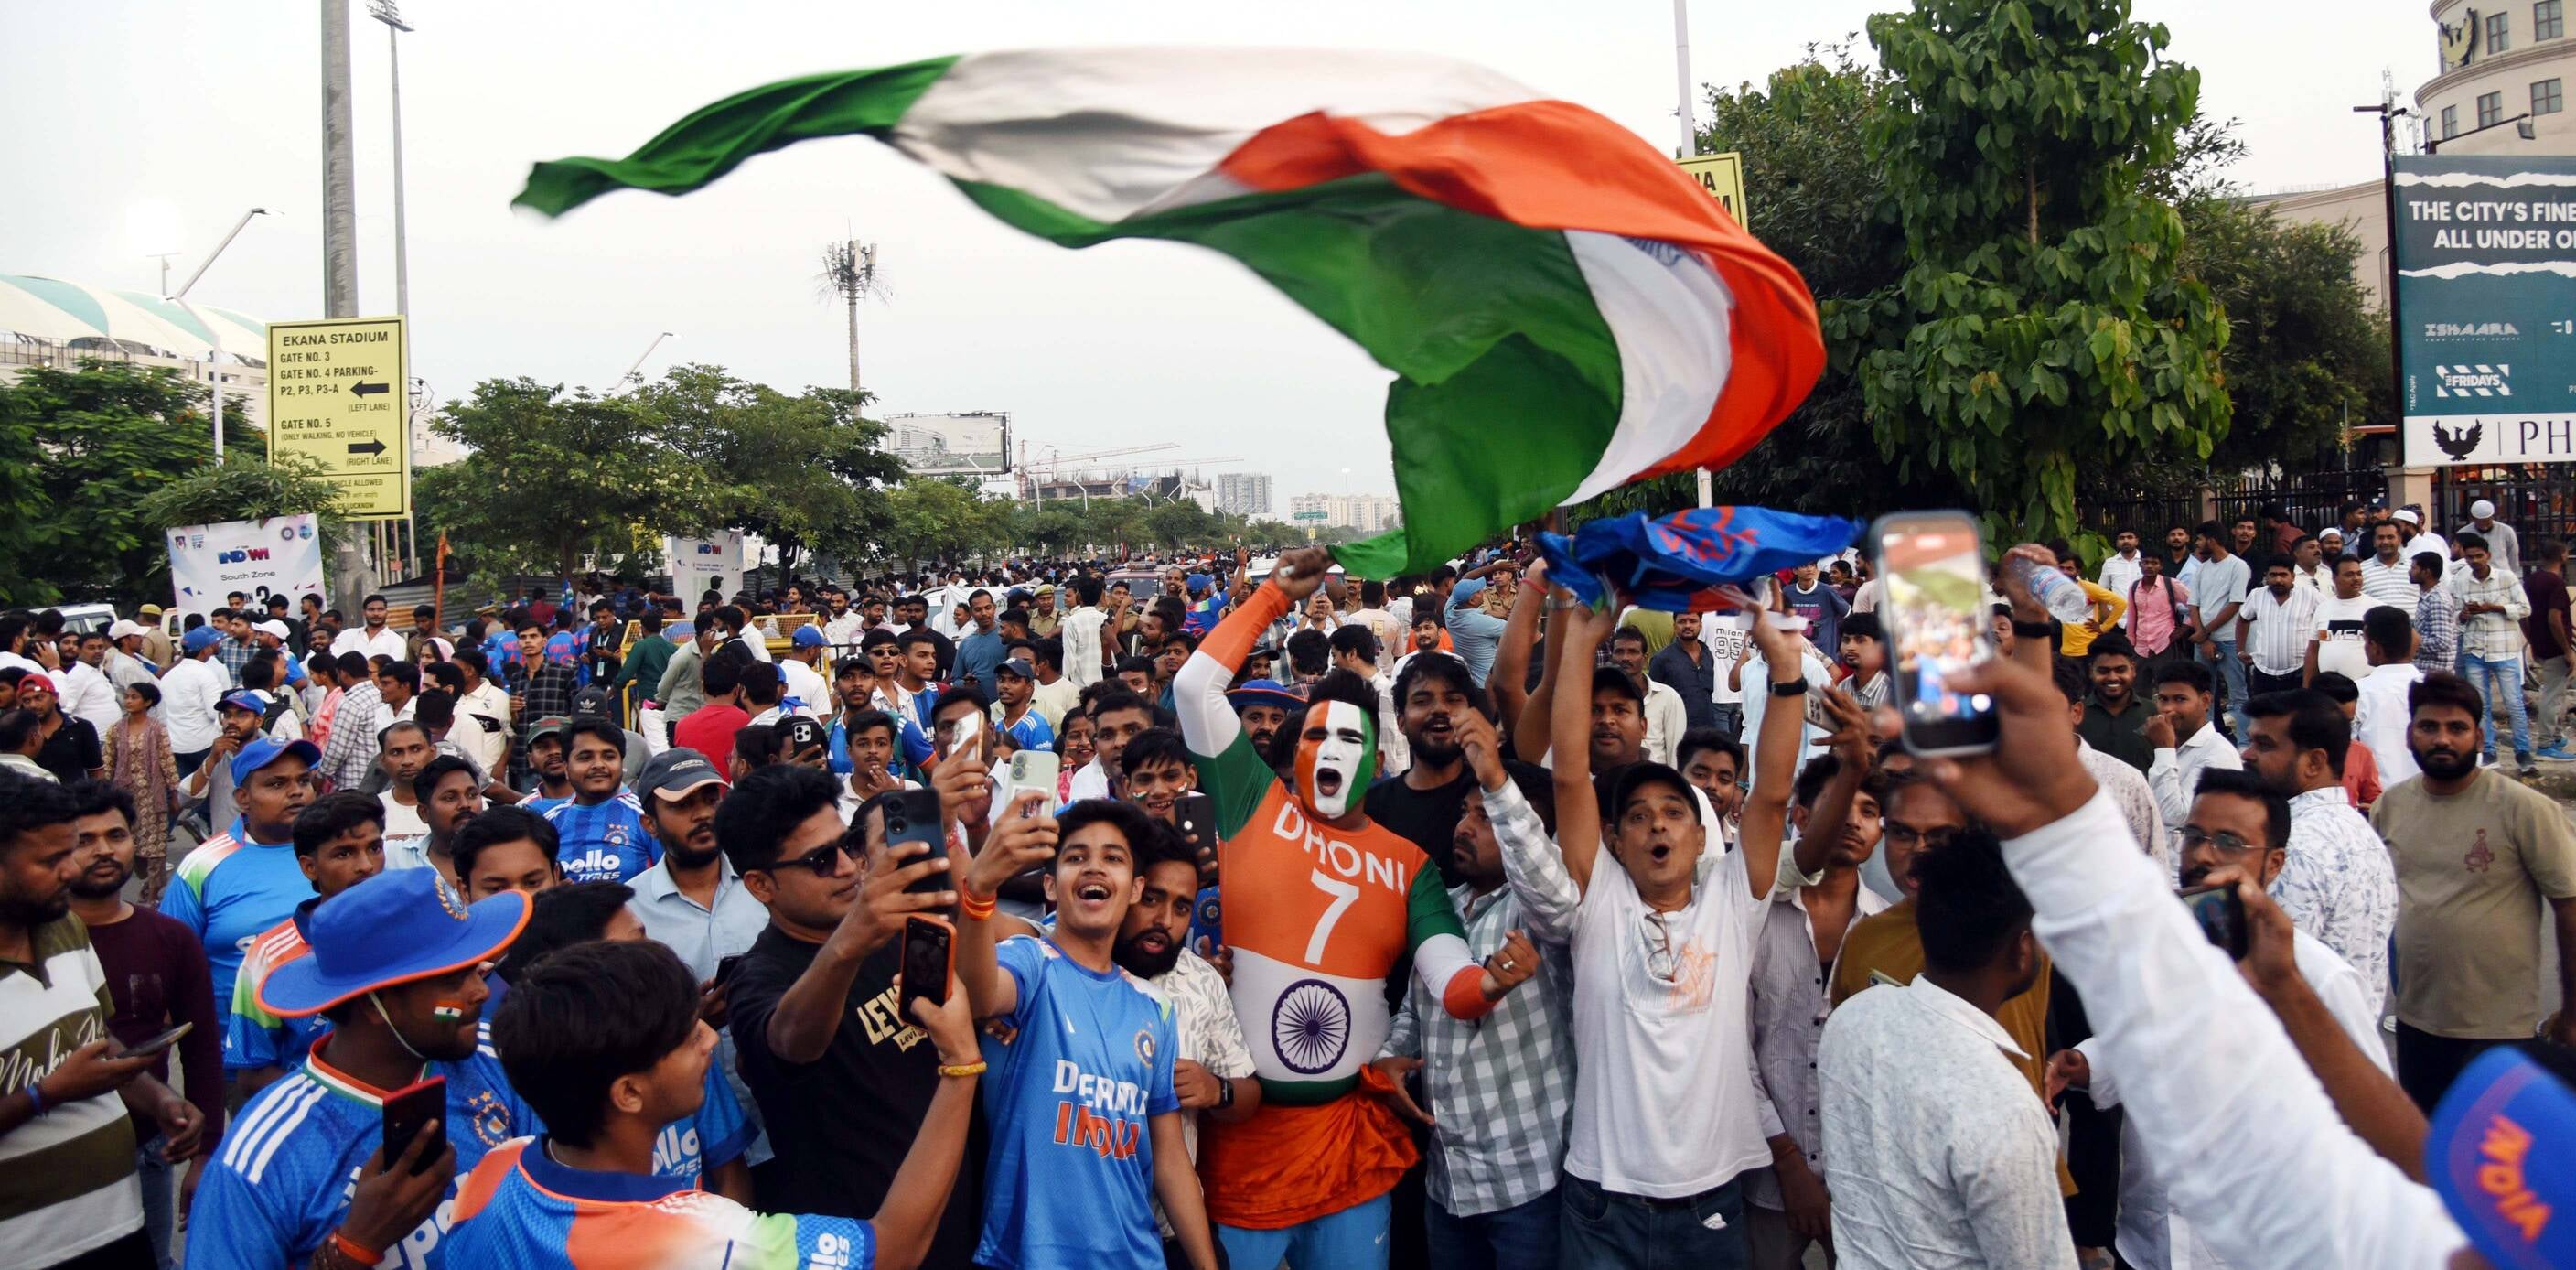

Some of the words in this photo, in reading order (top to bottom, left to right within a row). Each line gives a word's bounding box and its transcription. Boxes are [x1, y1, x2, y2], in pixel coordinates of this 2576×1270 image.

[2409, 201, 2452, 221] THE
[2455, 201, 2528, 221] CITY'S
[2533, 202, 2576, 221] FINE
[2433, 230, 2472, 249] ALL
[2477, 230, 2551, 249] UNDER
[2424, 323, 2520, 337] ISHAARA
[283, 334, 327, 347] EKANA
[330, 331, 389, 345] STADIUM
[280, 352, 303, 363] GATE
[306, 352, 321, 362] NO.
[324, 351, 331, 361] 3
[280, 369, 303, 380] GATE
[306, 368, 321, 379] NO.
[324, 368, 331, 378] 4
[333, 366, 379, 377] PARKING-
[2453, 374, 2502, 386] FRIDAYS
[280, 385, 295, 397] P2,
[298, 384, 313, 396] P3,
[317, 384, 339, 394] P3-A
[348, 404, 367, 413] (LEFT
[369, 403, 391, 412] LANE)
[281, 419, 303, 430] GATE
[306, 418, 322, 429] NO.
[325, 418, 331, 428] 5
[335, 430, 346, 439] NO
[2519, 419, 2571, 455] PH
[346, 457, 370, 467] (RIGHT
[371, 457, 392, 466] LANE)
[354, 479, 383, 487] ALLOWED
[220, 573, 250, 581] South
[1272, 801, 1405, 897] DHONI
[578, 871, 621, 882] TYRES
[1304, 867, 1360, 965] 7
